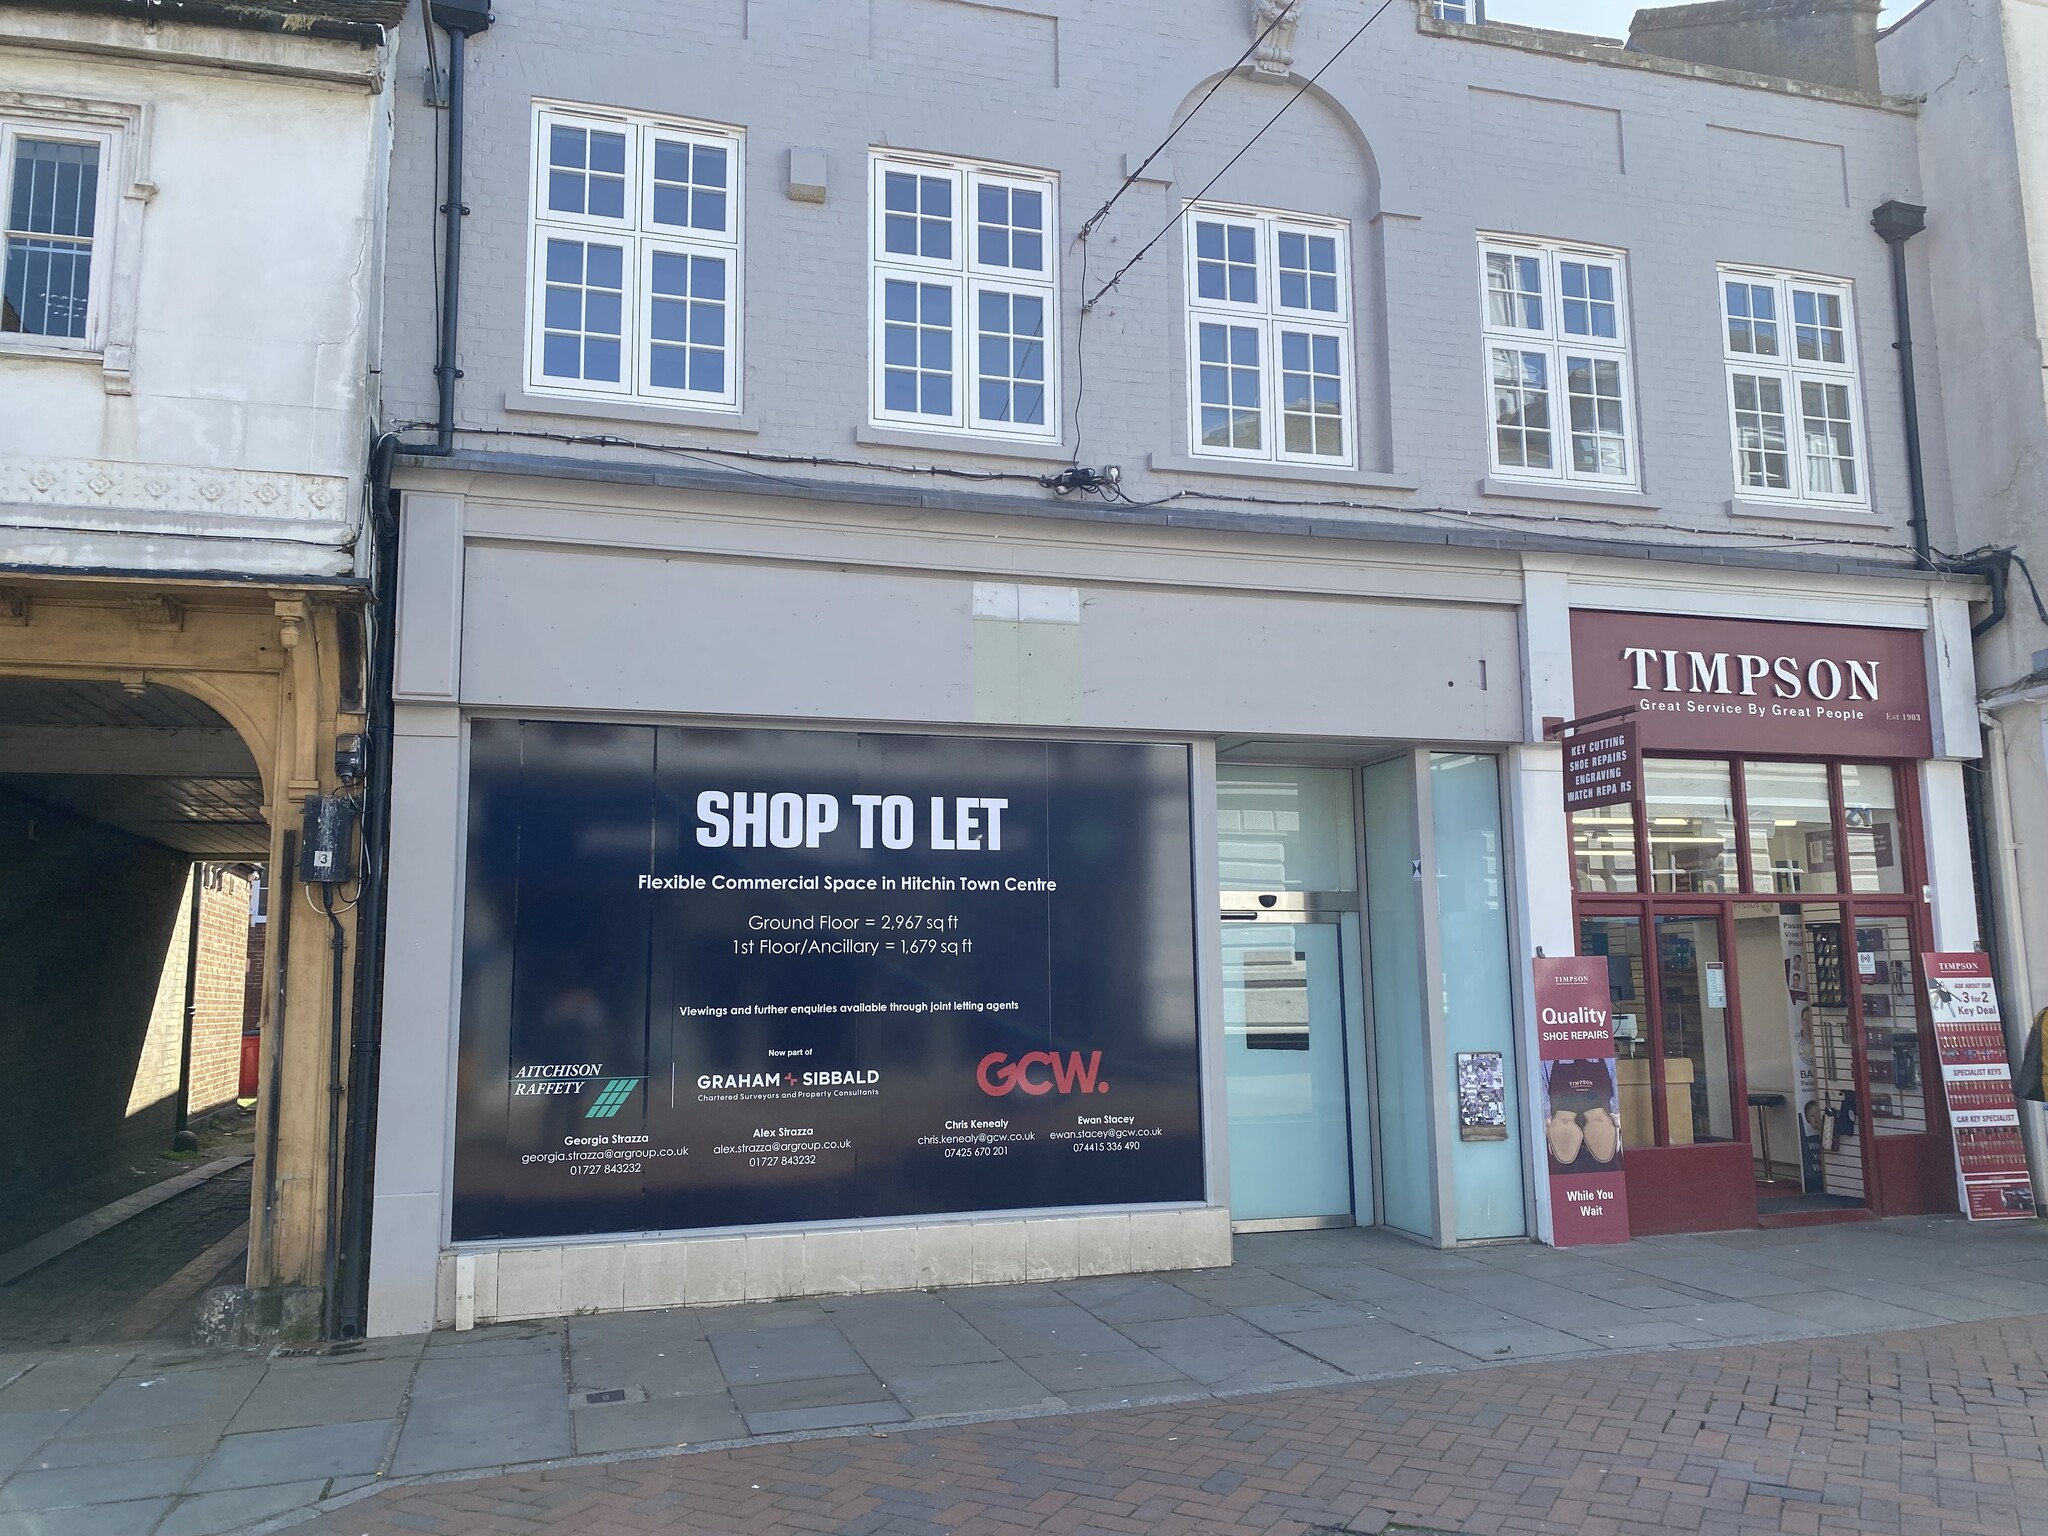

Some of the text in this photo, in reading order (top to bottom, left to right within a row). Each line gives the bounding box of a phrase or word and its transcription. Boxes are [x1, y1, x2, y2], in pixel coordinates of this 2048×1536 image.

[1623, 647, 1880, 701] TIMPSON
[1640, 698, 1864, 722] Great Service By Great People
[1902, 713, 1921, 721] 1903
[1571, 735, 1624, 756] KEY CUTTING
[1569, 751, 1627, 772] SHOE REPAIRS
[1576, 767, 1621, 785] ENGRAVING
[1568, 788, 1593, 802] WATCH
[697, 791, 1009, 851] SHOP TO LET
[320, 854, 327, 864] 3
[638, 874, 1057, 894] Flexible Commercial Space in Hitchin Town Centre
[748, 915, 814, 930] Ground
[820, 915, 859, 930] Floor
[881, 915, 923, 932] 2,967
[926, 918, 944, 935] sq
[947, 915, 958, 930] ft
[733, 939, 754, 955] 1st
[759, 938, 879, 956] Floor/Ancillary
[900, 938, 936, 956] 1,679
[940, 942, 958, 958] sq
[961, 938, 972, 953] ft
[1962, 992, 1969, 1003] 3
[1981, 991, 1989, 1002] 2
[680, 1000, 1019, 1017] Viewings and further enquiries available through joint letting agents
[1958, 1006, 1996, 1016] Key Deal
[1542, 1007, 1606, 1026] Quality
[1543, 1031, 1609, 1041] SHOE REPAIRS
[768, 1048, 812, 1058] Now part of
[515, 1063, 602, 1079] AITCHISON
[976, 1050, 1110, 1097] GCW.
[697, 1073, 780, 1090] GRAHAM
[802, 1070, 880, 1086] SIBBALD
[514, 1081, 586, 1096] RAFFETY
[697, 1088, 879, 1102] Chartered Surveyors and Property Consultants
[944, 1118, 1009, 1130] Chris Kenealy
[1078, 1115, 1134, 1124] Ewan Stacey
[752, 1127, 813, 1138] Alex Strazza
[917, 1131, 1035, 1146] chris.kenealy@gcw.co.uk
[1050, 1127, 1162, 1139] ewan.stacey@gcw.co.uk
[564, 1134, 648, 1147] Georgia Strazza
[713, 1139, 851, 1154] alex.strazza@argroup.co.uk
[1073, 1141, 1140, 1152] 074415 336 490
[522, 1146, 689, 1165] georgia.strazza@argroup.co.uk
[944, 1146, 1008, 1158] 07425 670 201
[749, 1155, 816, 1167] 01727 843232
[570, 1163, 641, 1176] 01727 843232
[1567, 1189, 1613, 1201] While You
[1580, 1206, 1603, 1216] Wait
